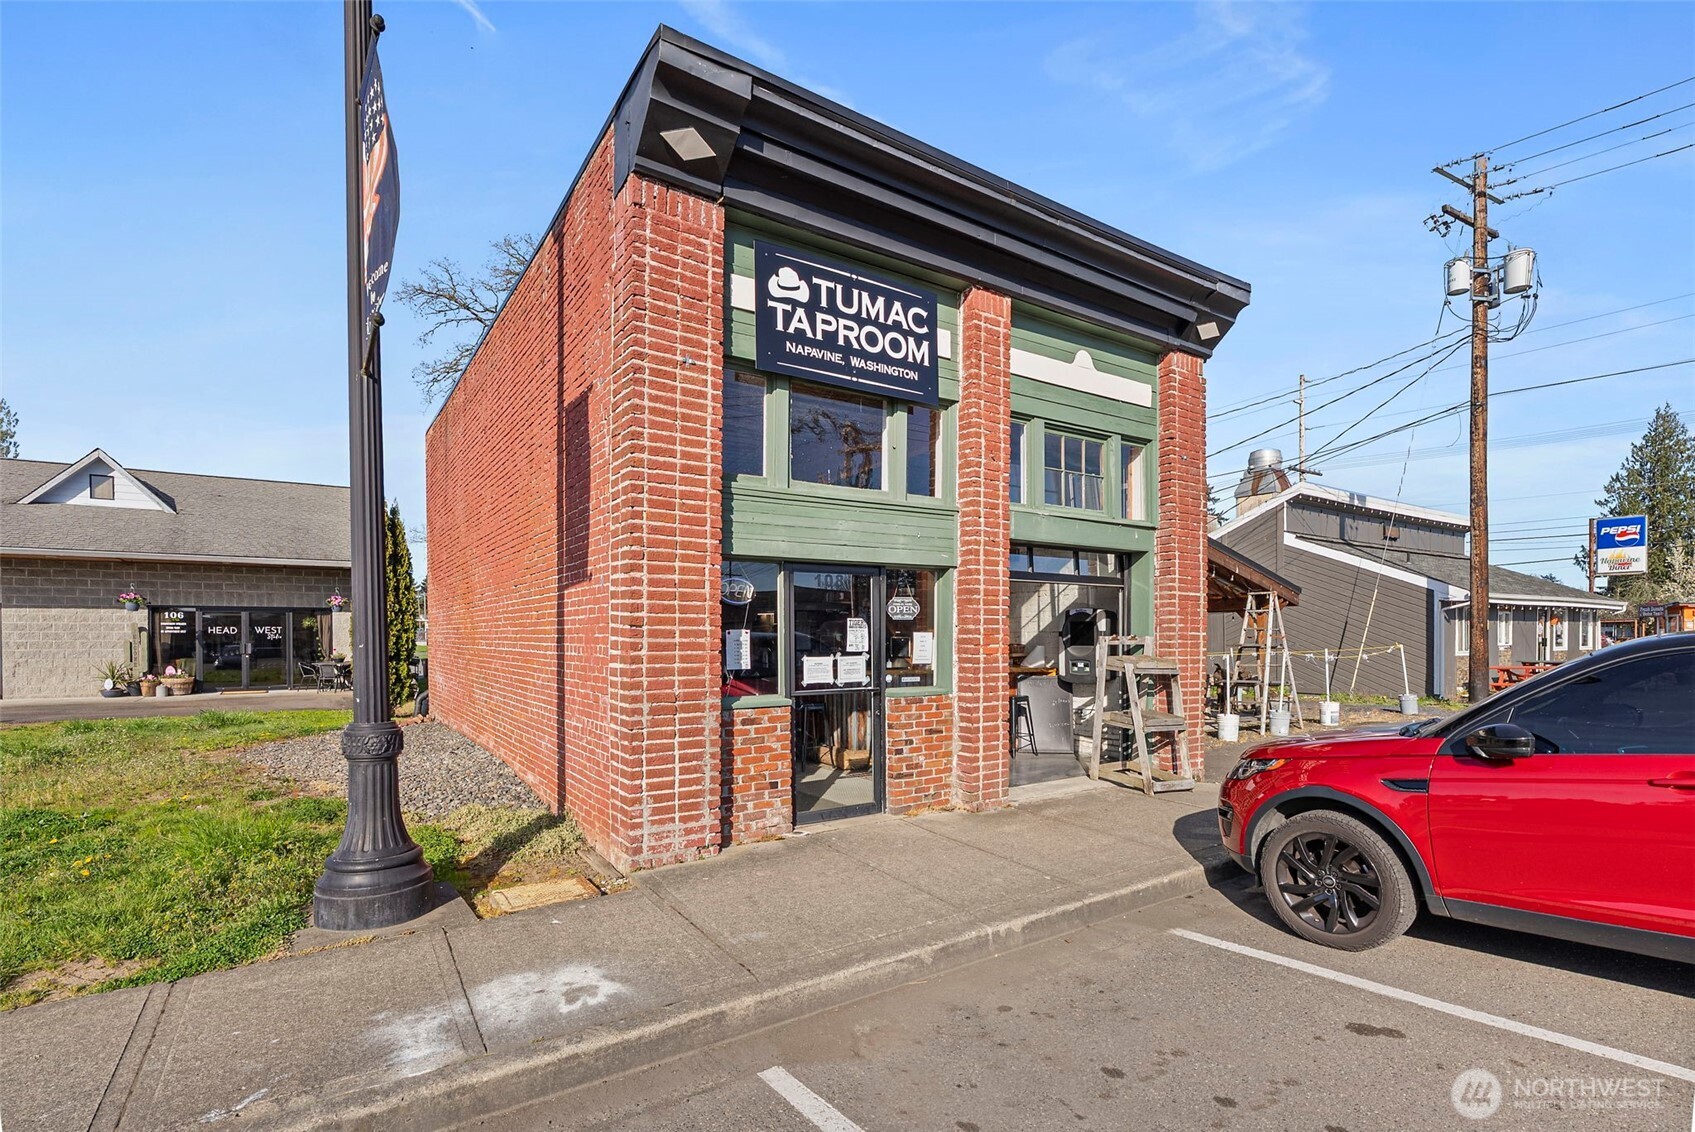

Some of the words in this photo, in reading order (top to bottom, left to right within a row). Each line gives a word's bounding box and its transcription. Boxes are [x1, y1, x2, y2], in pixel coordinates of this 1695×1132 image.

[812, 275, 929, 334] TUMAC
[767, 298, 930, 367] TAPROOM
[786, 341, 845, 366] NAPAVINE,
[850, 355, 918, 381] WASHINGTON
[1600, 524, 1641, 536] PEPSI
[164, 611, 184, 619] 106
[888, 605, 918, 614] OPEN
[208, 626, 238, 635] HEAD
[254, 626, 283, 634] WEST
